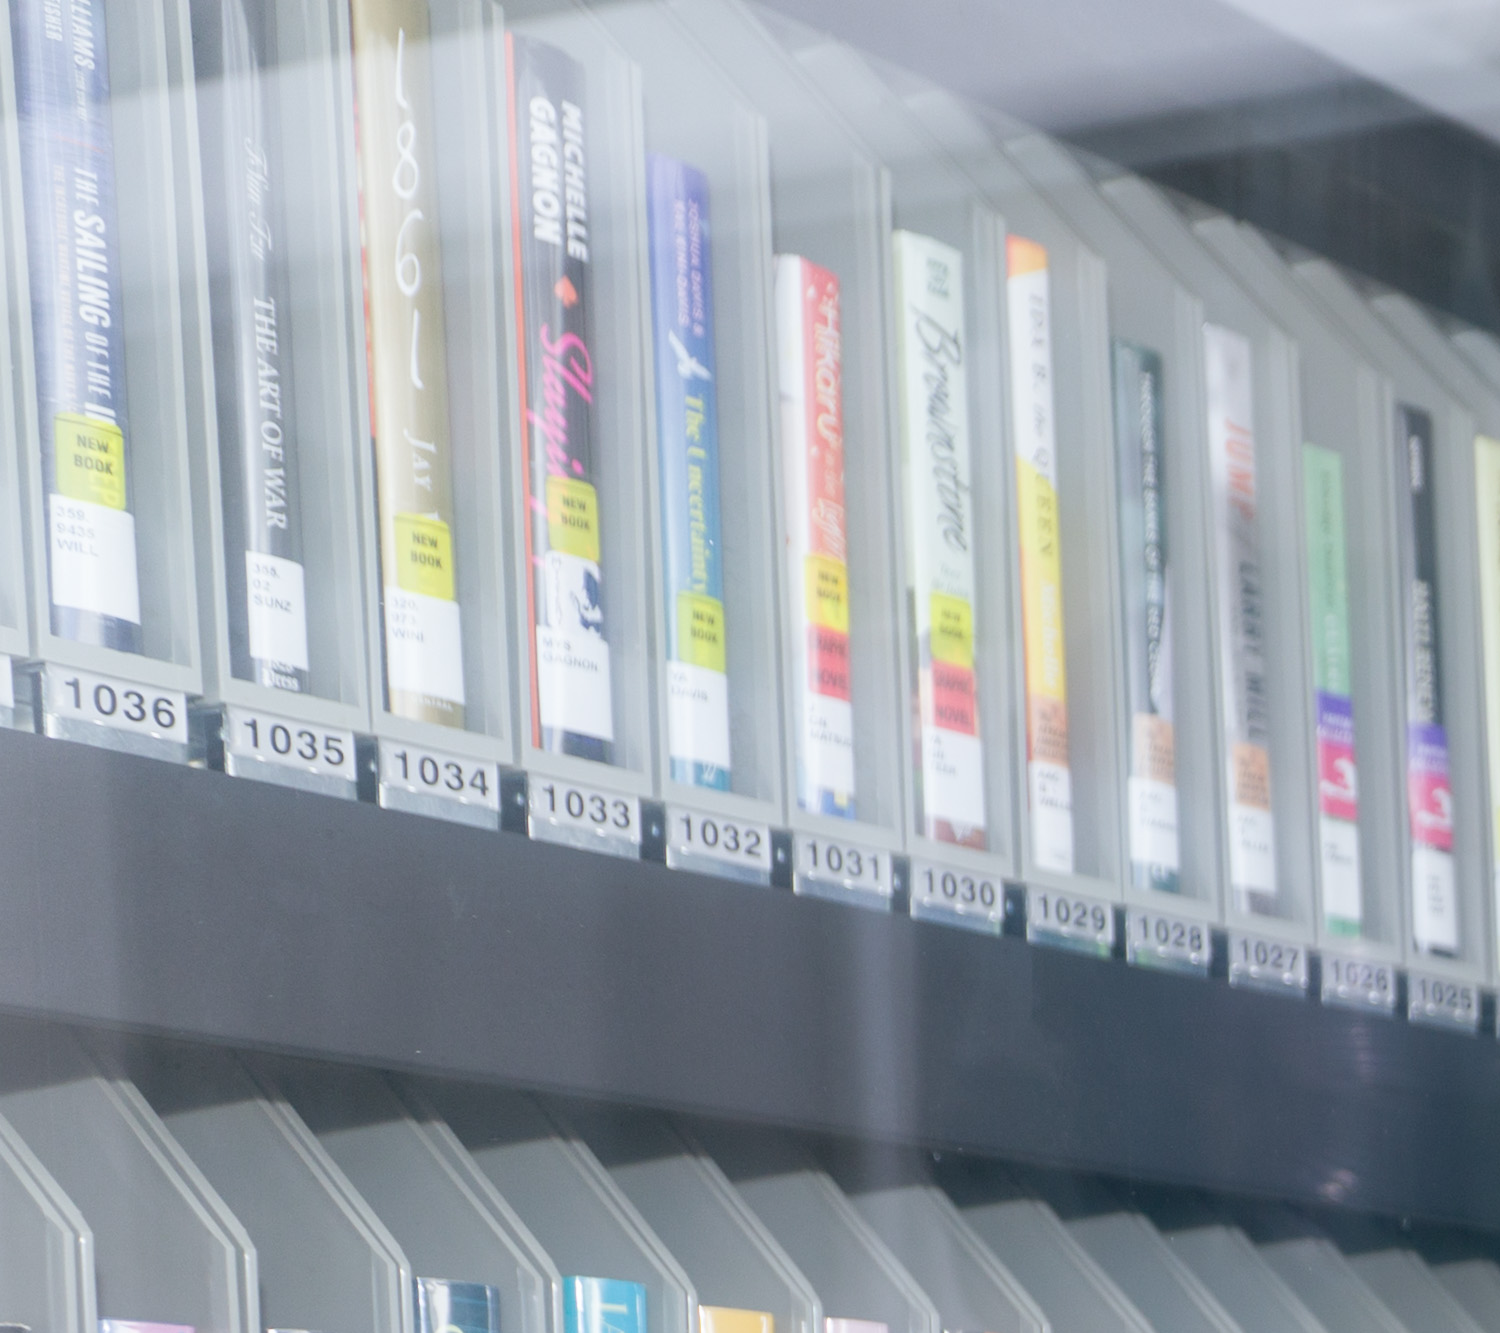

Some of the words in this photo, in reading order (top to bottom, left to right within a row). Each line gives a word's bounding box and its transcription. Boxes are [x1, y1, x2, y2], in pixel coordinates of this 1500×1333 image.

[529, 96, 563, 247] GAGNON
[561, 99, 589, 263] MICHELLE
[74, 210, 111, 328] SAILING
[254, 296, 278, 355] THE
[257, 358, 282, 416] ART
[76, 434, 110, 454] NEW
[261, 421, 285, 460] OF
[74, 454, 113, 476] BOOK
[262, 462, 287, 530] WAR
[562, 494, 587, 511] NEW
[411, 550, 443, 570] BOOK
[412, 531, 438, 549] NEW
[64, 677, 176, 729] 1036
[243, 718, 346, 767] 1035
[395, 751, 489, 797] 1034
[542, 783, 631, 829] 1033
[682, 813, 762, 857] 1032
[806, 840, 881, 881] 1031
[923, 868, 996, 907] 1030
[1039, 893, 1106, 931] 1029
[1139, 917, 1203, 951] 1028
[1241, 938, 1299, 970] 1027
[1332, 962, 1388, 992] 1026
[1420, 978, 1472, 1010] 1025
